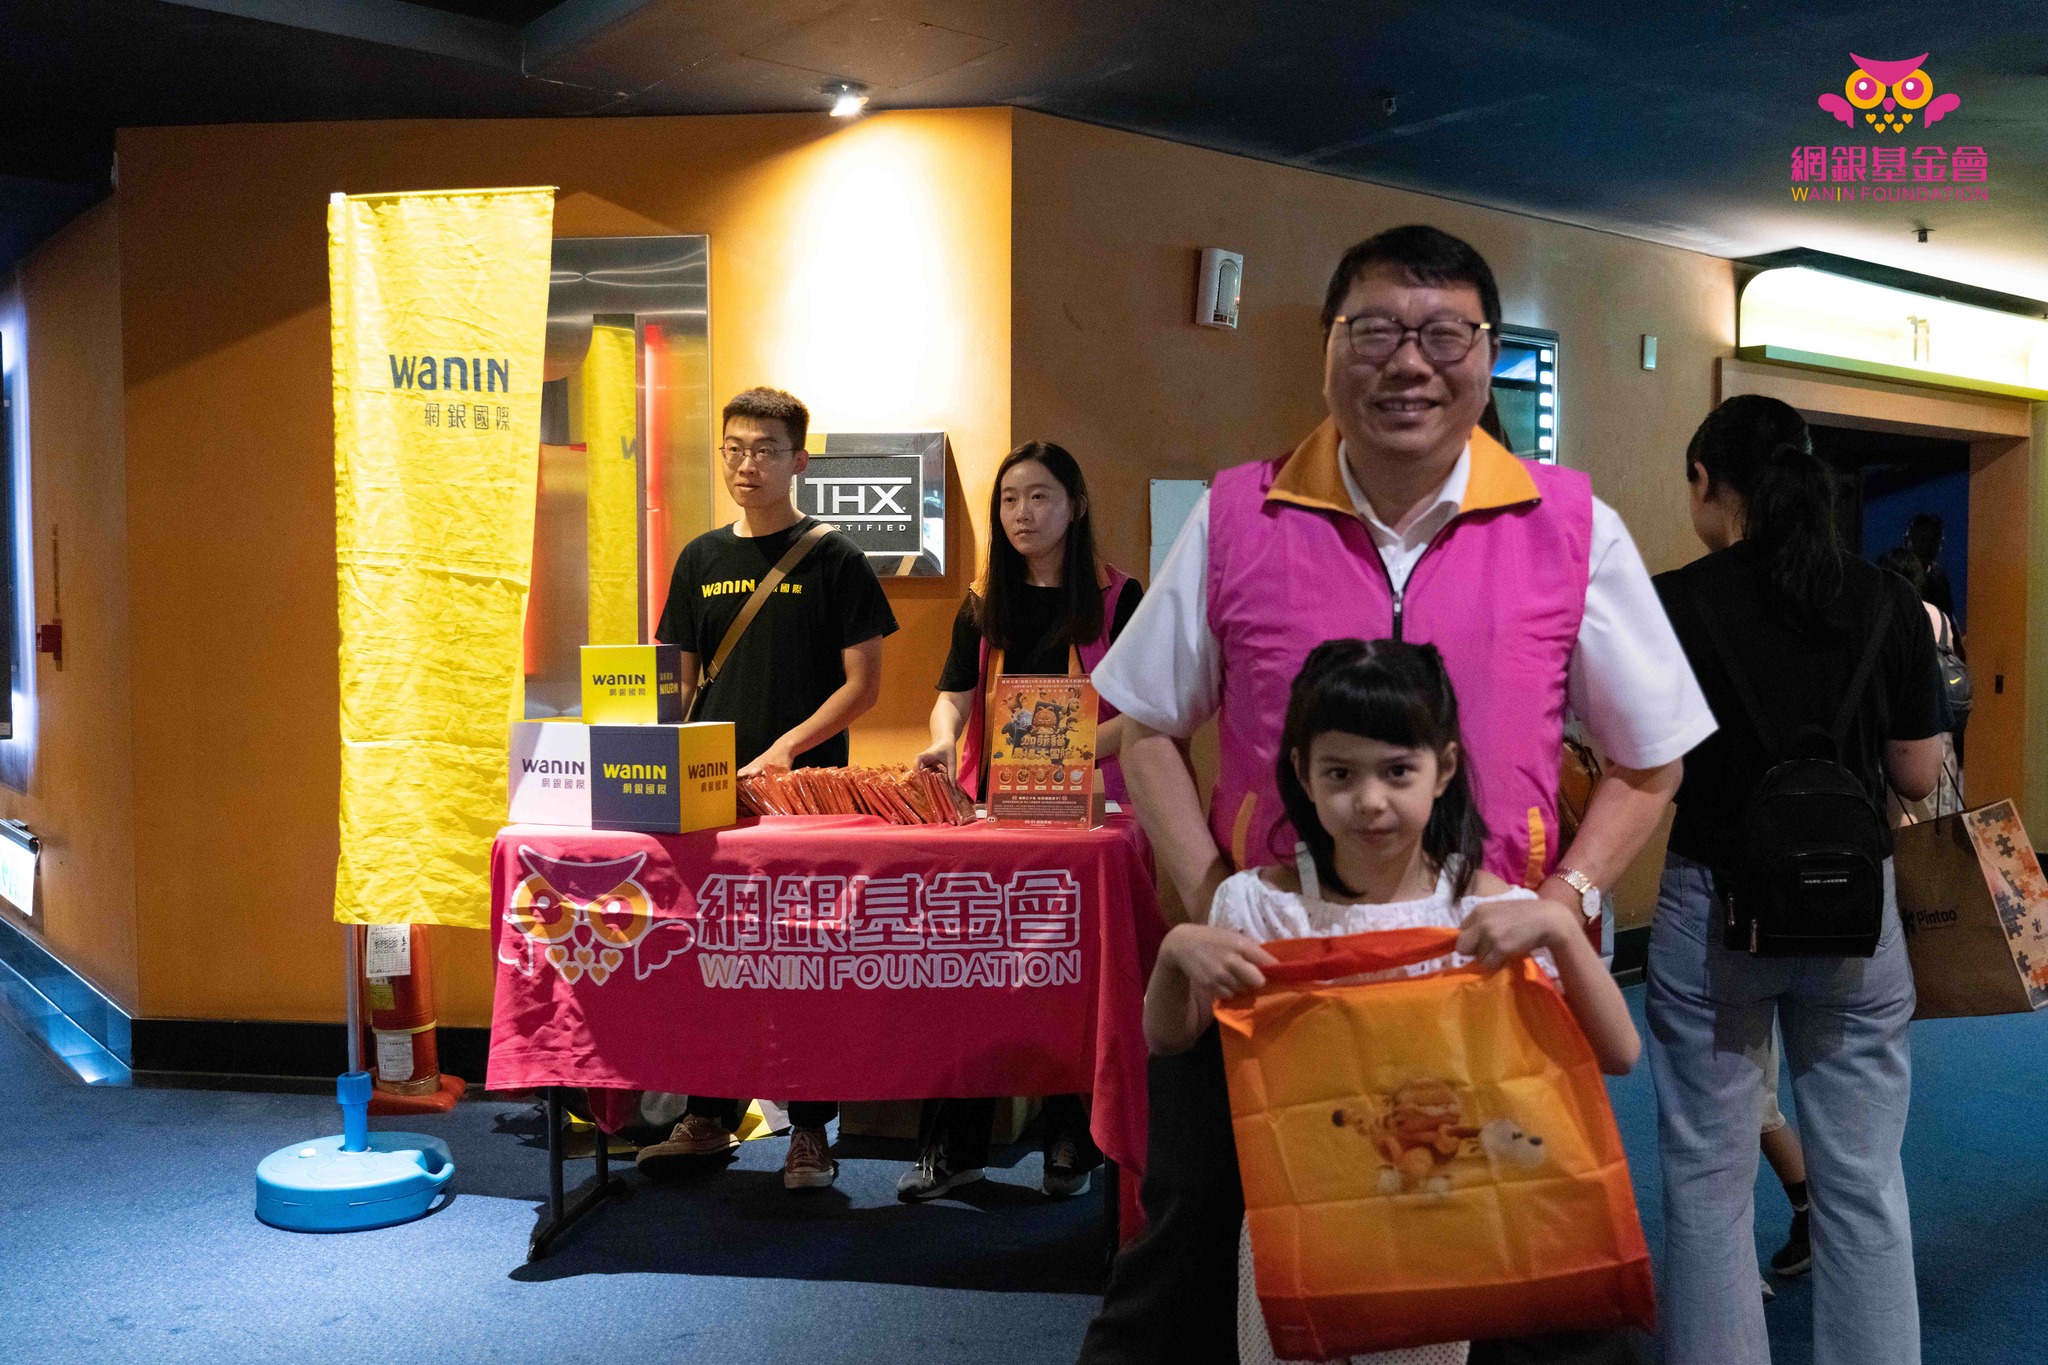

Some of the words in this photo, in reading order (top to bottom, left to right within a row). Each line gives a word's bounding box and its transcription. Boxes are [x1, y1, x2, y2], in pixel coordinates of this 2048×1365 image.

[424, 402, 510, 431] 網銀國際
[804, 477, 912, 514] THX
[834, 524, 906, 532] RTIFIED
[622, 783, 667, 795] 網銀國際
[696, 869, 1081, 952] 網銀基金會
[697, 952, 825, 990] WANIN
[829, 949, 1082, 990] FOUNDATION
